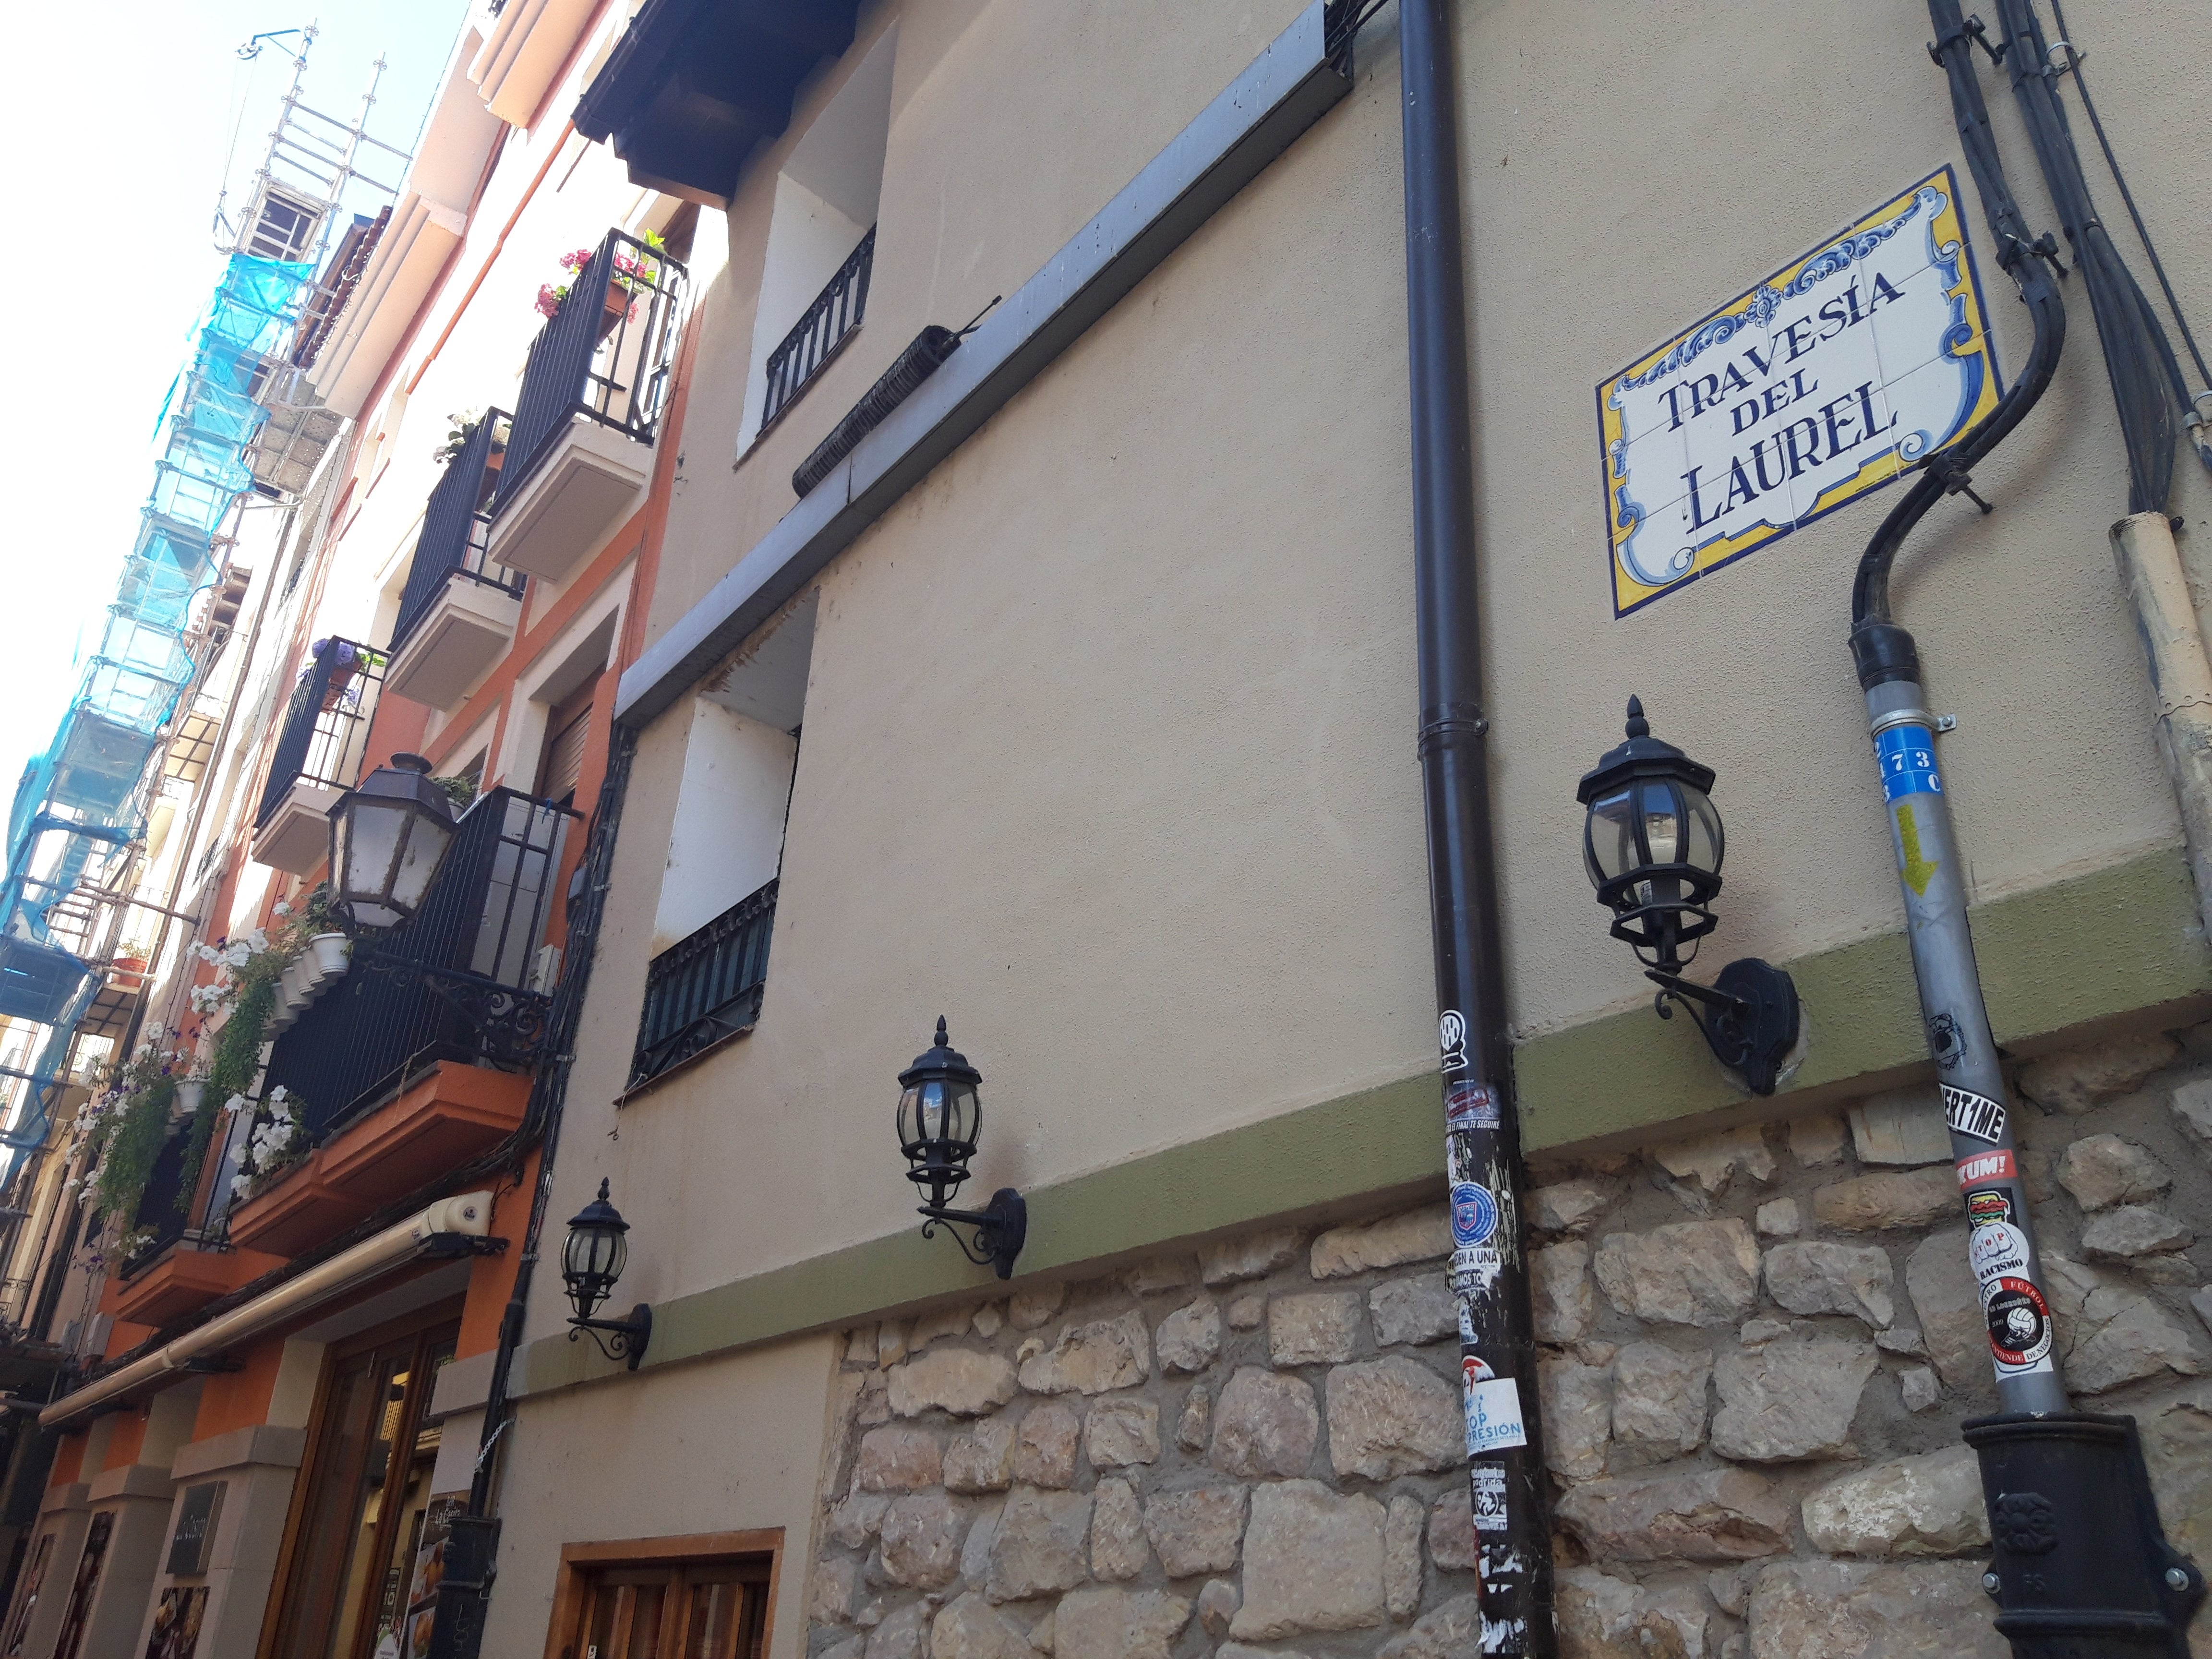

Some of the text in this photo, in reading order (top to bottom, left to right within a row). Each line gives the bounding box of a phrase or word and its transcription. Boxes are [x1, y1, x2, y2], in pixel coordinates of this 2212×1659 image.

[1658, 272, 1906, 433] TRAVESÍA
[1729, 368, 1819, 437] DEL
[1680, 381, 1899, 535] LAUREL
[1477, 1250, 1498, 1264] UNA
[1979, 1258, 2023, 1280] RACISMO
